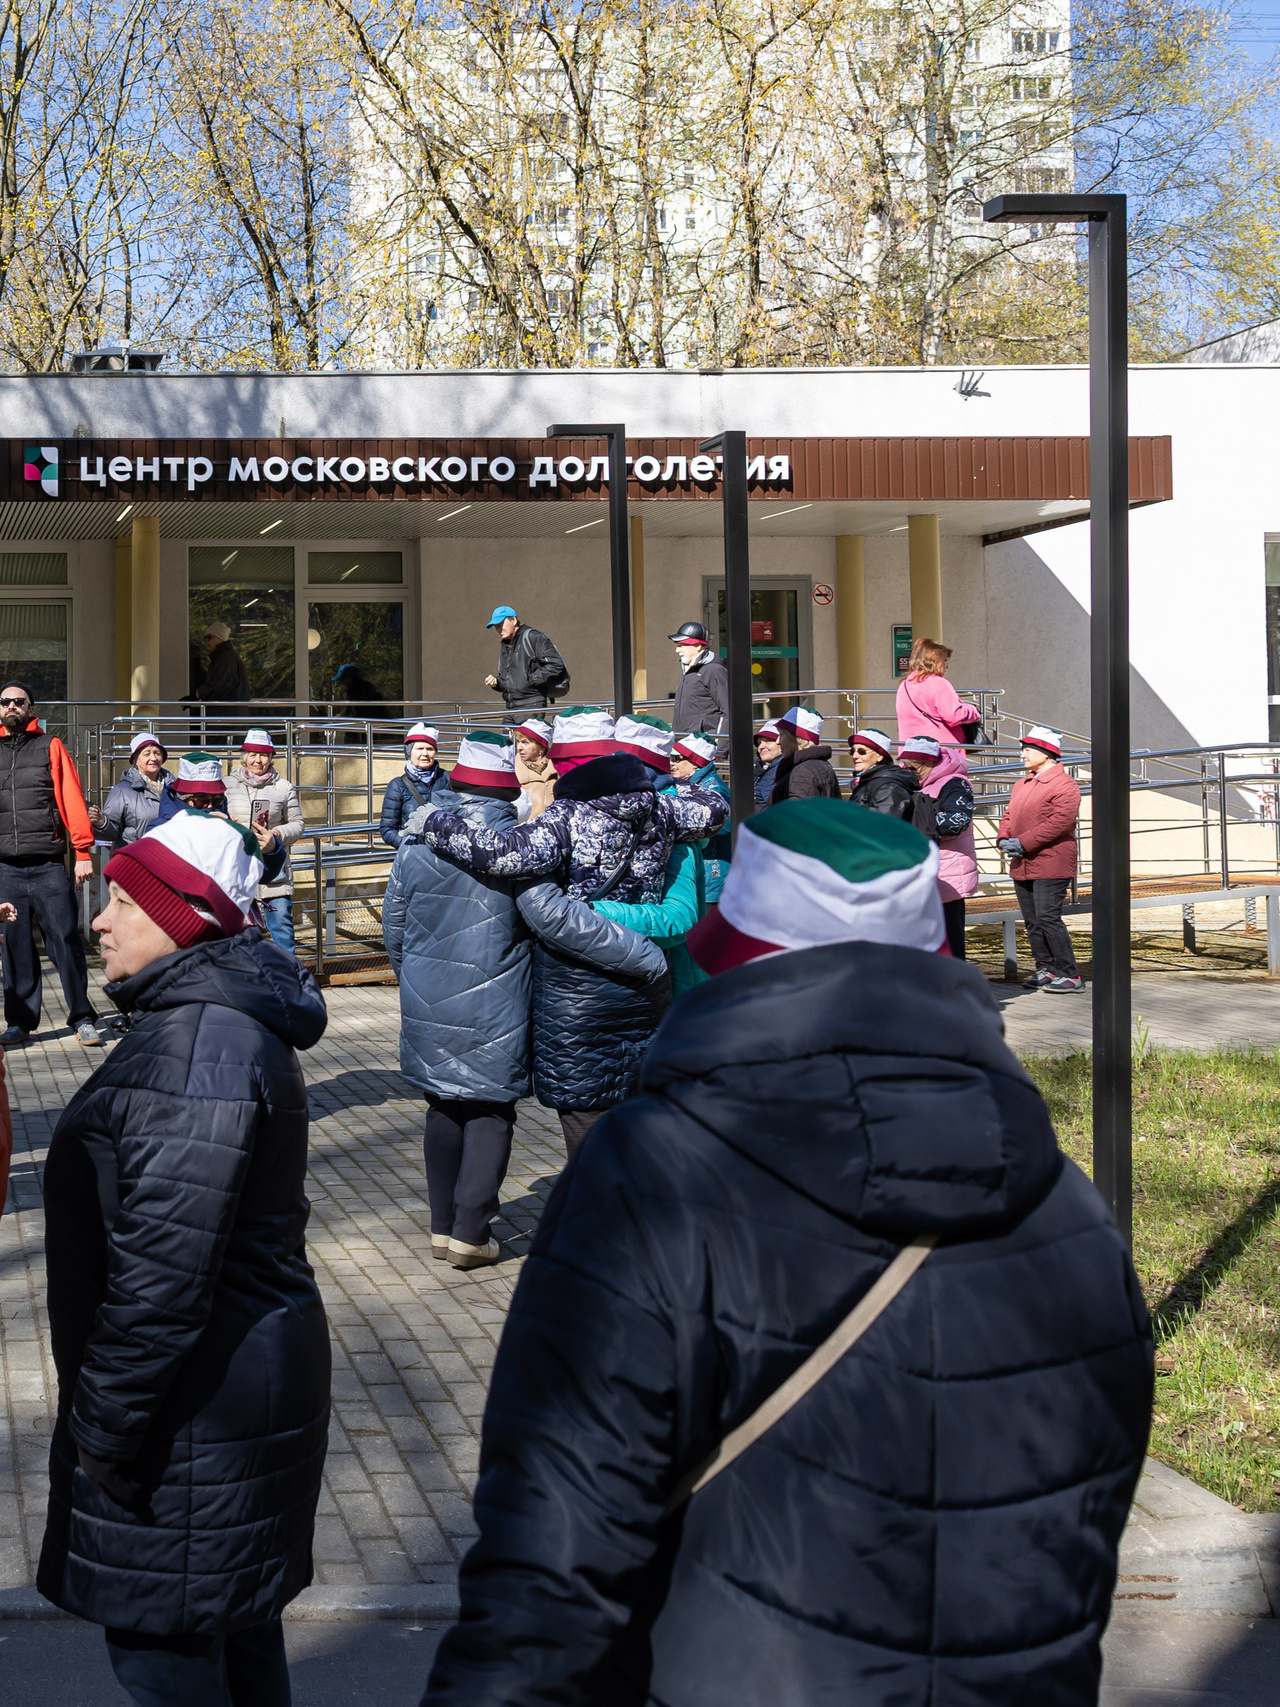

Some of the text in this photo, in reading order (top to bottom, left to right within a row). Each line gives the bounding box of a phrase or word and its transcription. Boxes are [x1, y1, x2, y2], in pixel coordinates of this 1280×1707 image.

[80, 454, 790, 491] центр московского дололеия
